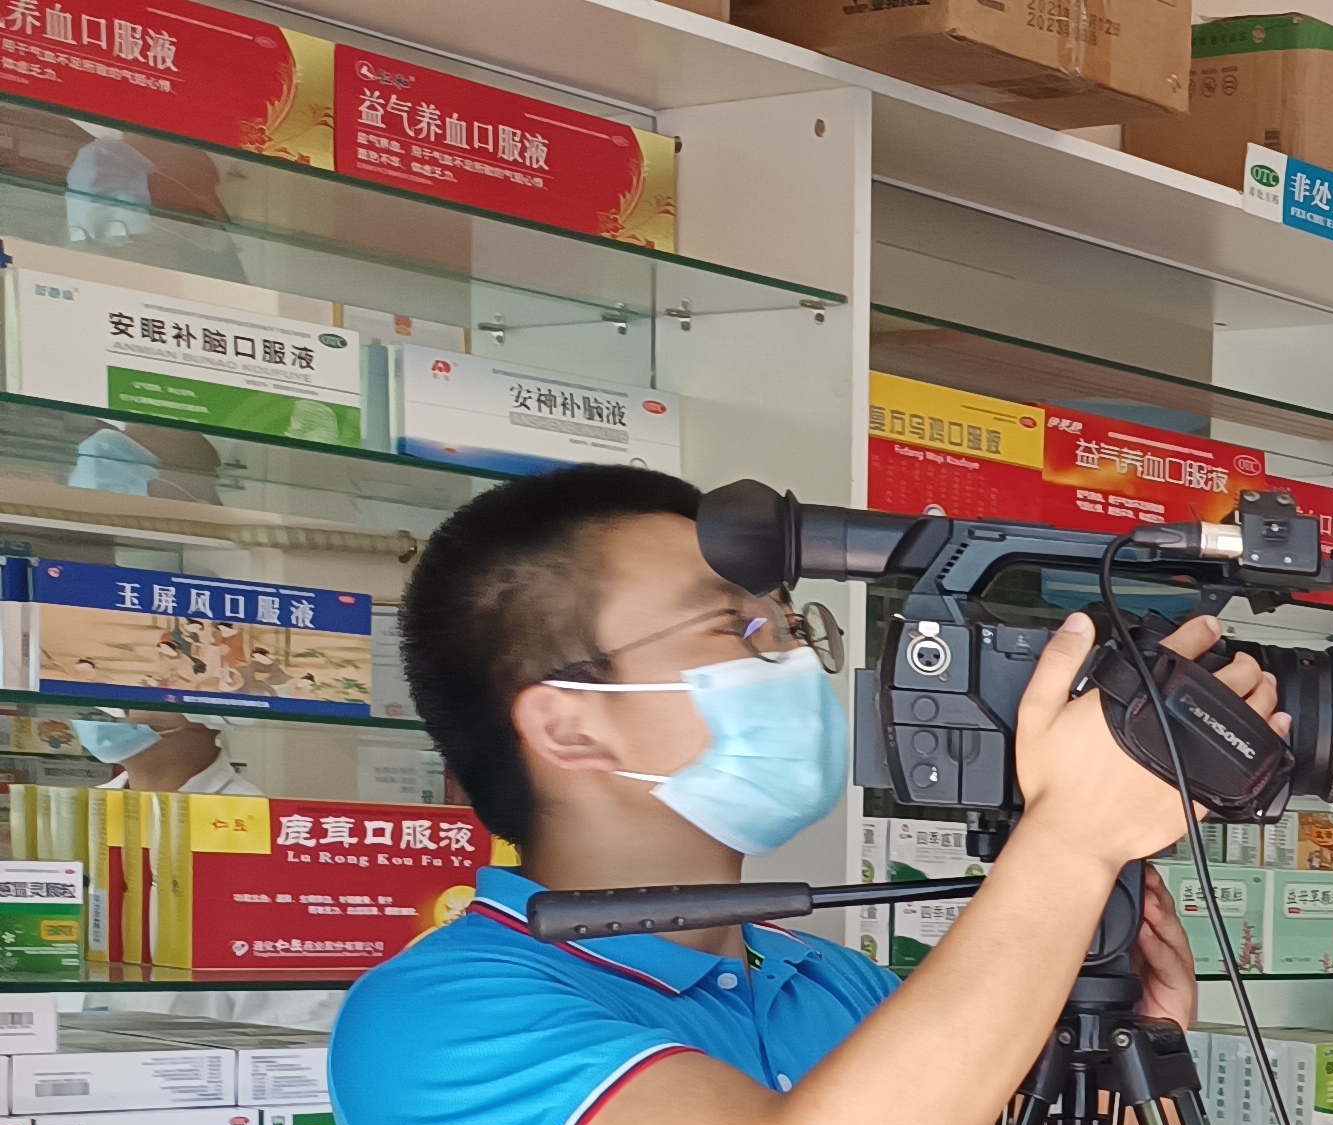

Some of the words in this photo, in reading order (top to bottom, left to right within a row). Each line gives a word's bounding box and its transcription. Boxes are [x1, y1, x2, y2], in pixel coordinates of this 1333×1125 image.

[0, 0, 179, 72] 养血口服液
[357, 87, 550, 171] 益气养血口服液
[1252, 166, 1279, 186] OTC
[108, 312, 316, 371] 安眠补脑口服液
[509, 383, 627, 427] 安神补脑液
[1076, 437, 1229, 495] 益气养血口服液
[115, 582, 315, 628] 玉屏风口服液
[277, 814, 476, 852] 鹿茸口服液
[287, 851, 311, 864] Lu
[318, 852, 370, 868] Rong
[377, 854, 414, 867] Kou
[421, 855, 443, 867] Fu
[452, 856, 473, 868] Ye
